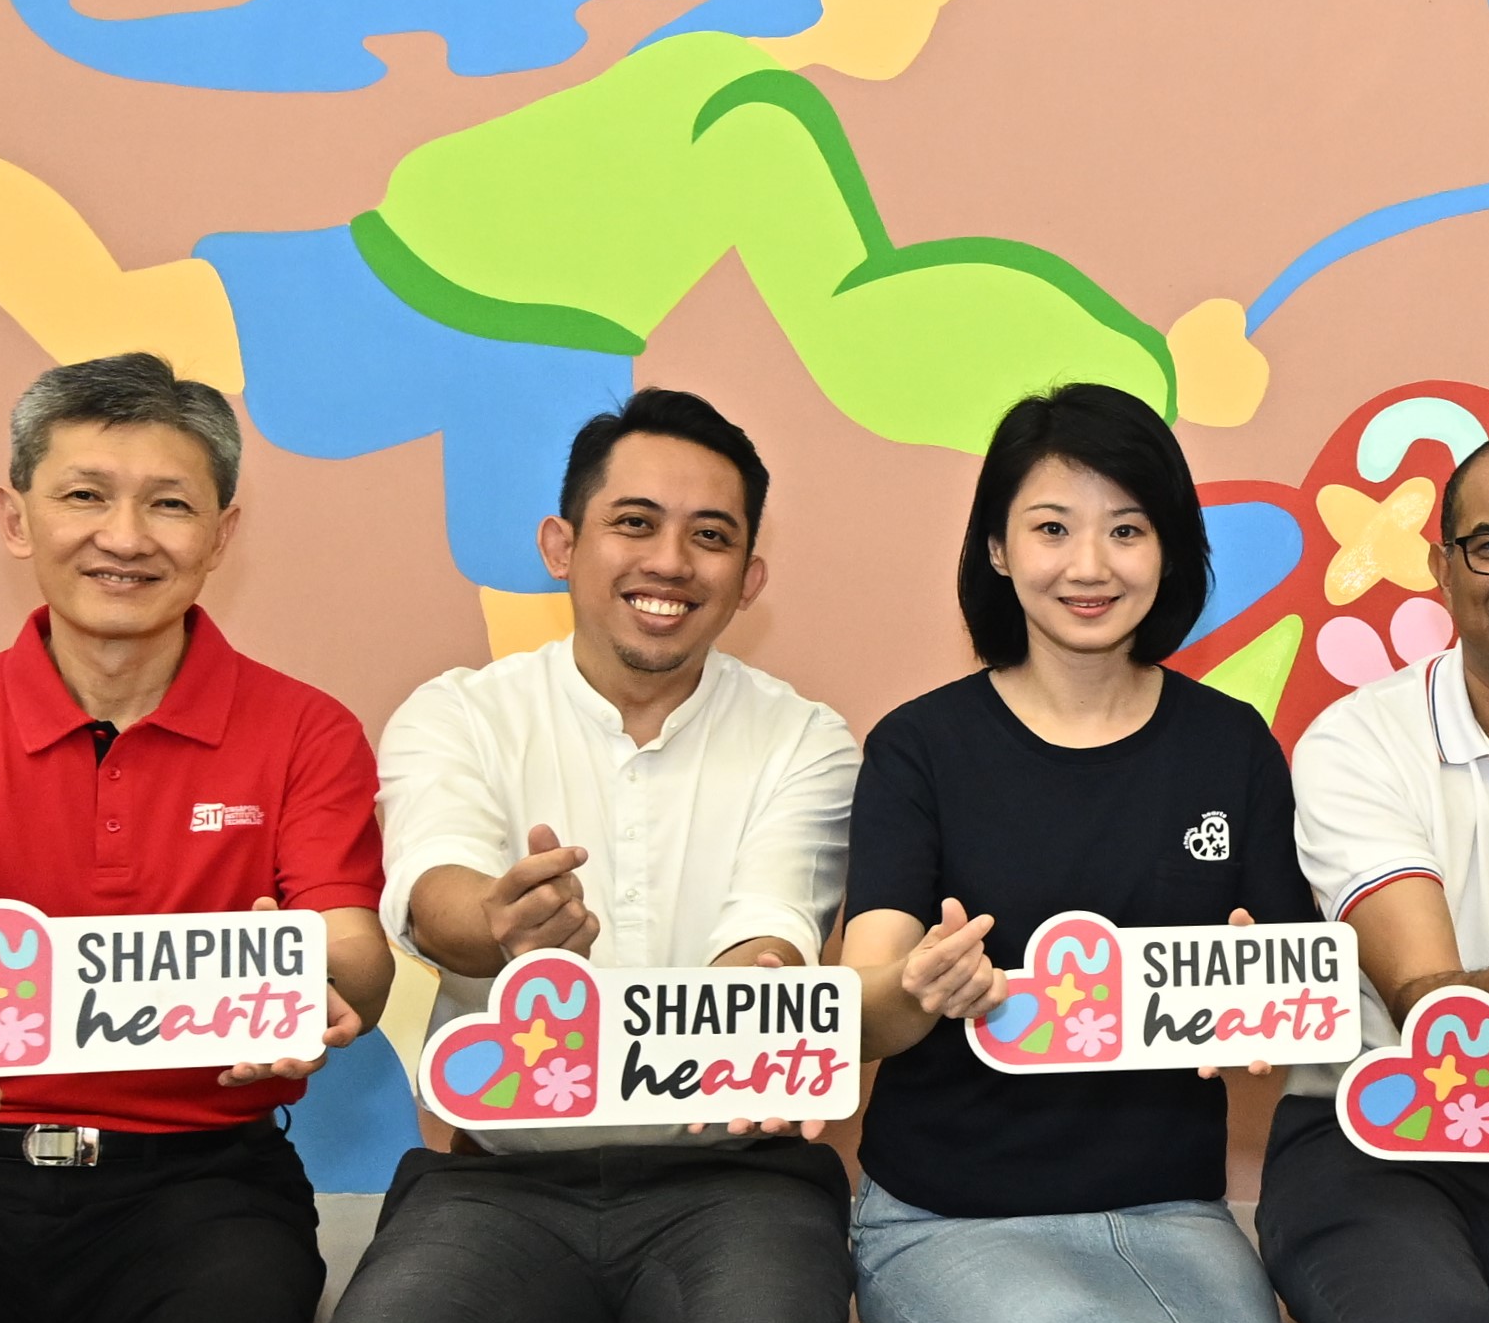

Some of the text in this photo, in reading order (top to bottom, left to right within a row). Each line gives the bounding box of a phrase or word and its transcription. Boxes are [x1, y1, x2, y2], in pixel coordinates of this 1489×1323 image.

[77, 926, 303, 984] SHAPING
[1143, 936, 1339, 989] SHAPING
[75, 982, 313, 1049] hearts
[623, 982, 839, 1037] SHAPING
[1143, 987, 1350, 1047] hearts
[620, 1038, 849, 1102] hearts
